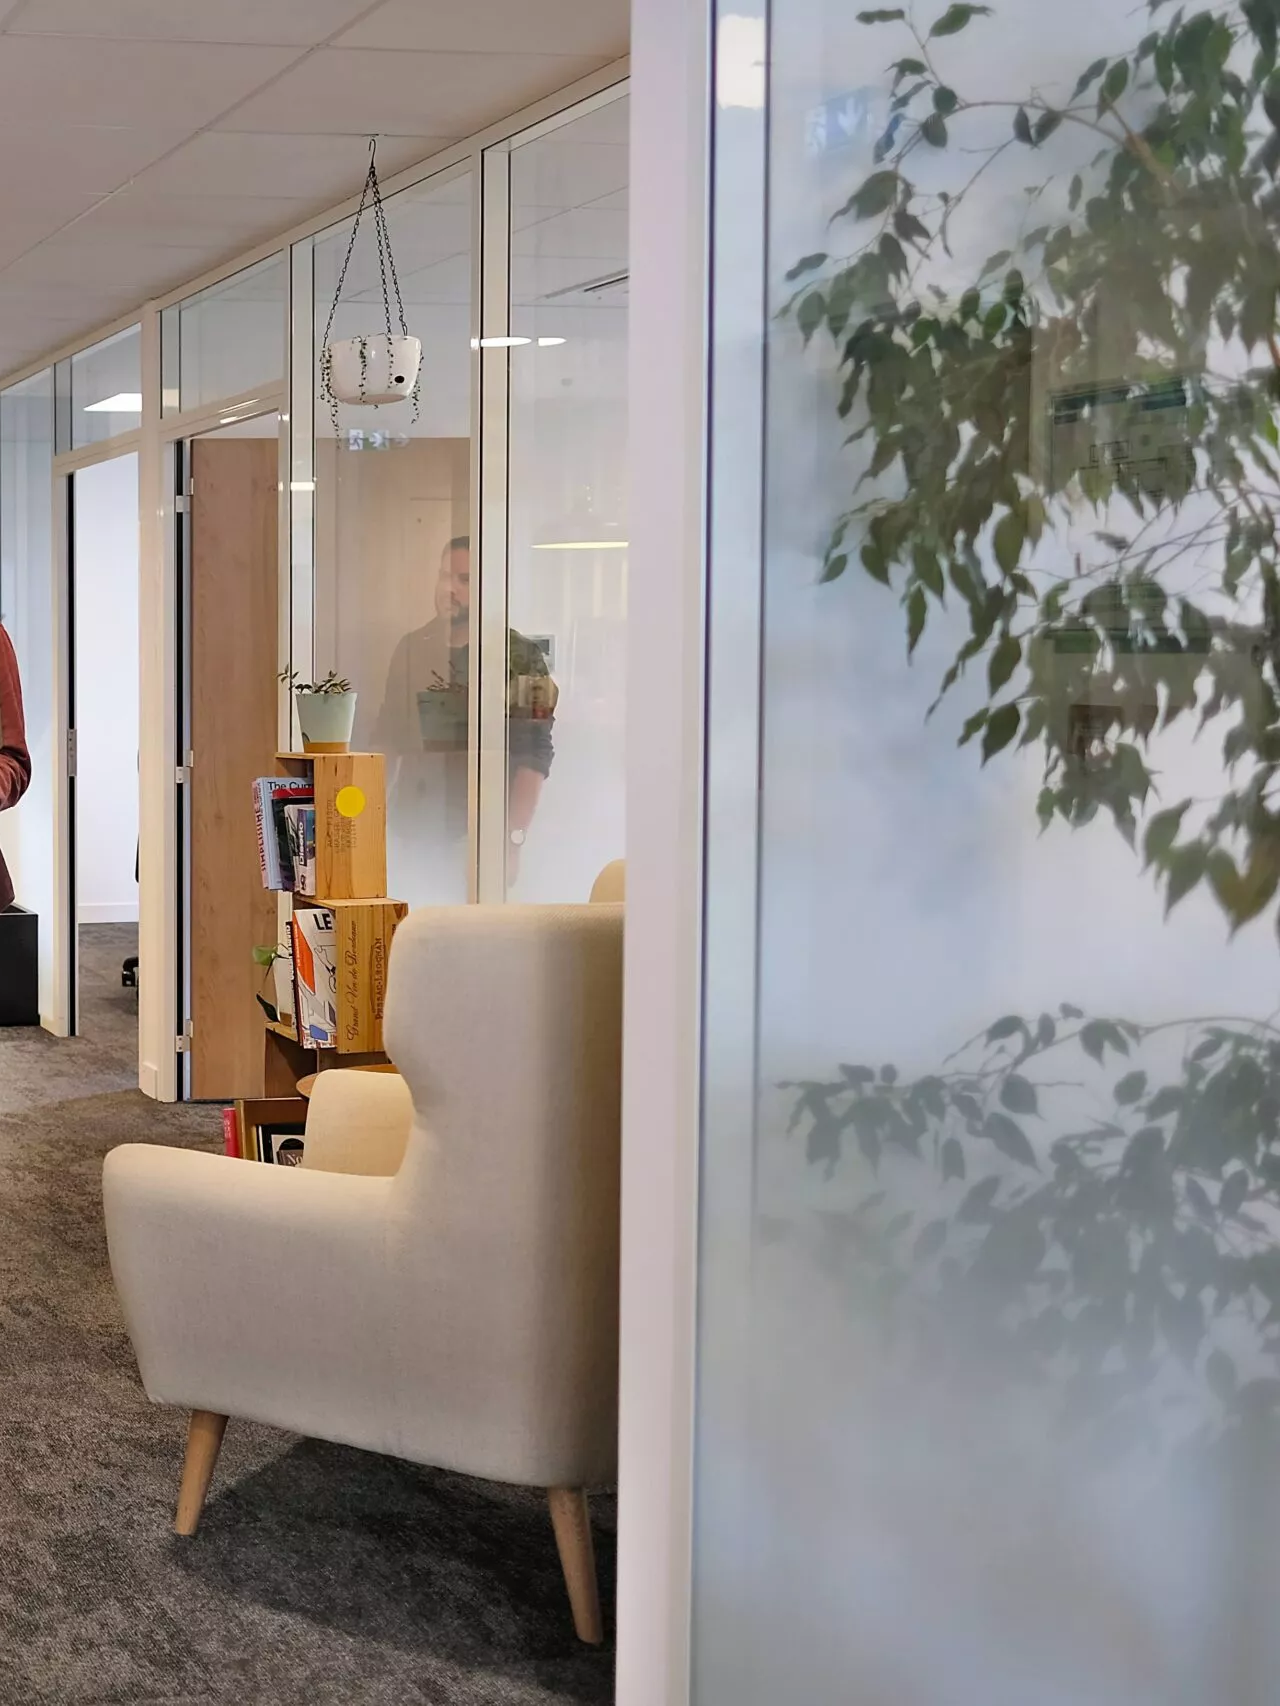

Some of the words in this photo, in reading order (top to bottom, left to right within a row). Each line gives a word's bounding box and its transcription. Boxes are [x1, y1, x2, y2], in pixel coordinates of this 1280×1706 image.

[267, 781, 287, 791] The
[312, 913, 333, 931] LE
[344, 920, 358, 967] Bordeaux
[348, 967, 359, 980] de
[344, 981, 358, 1004] Vin
[344, 1005, 360, 1041] Grand
